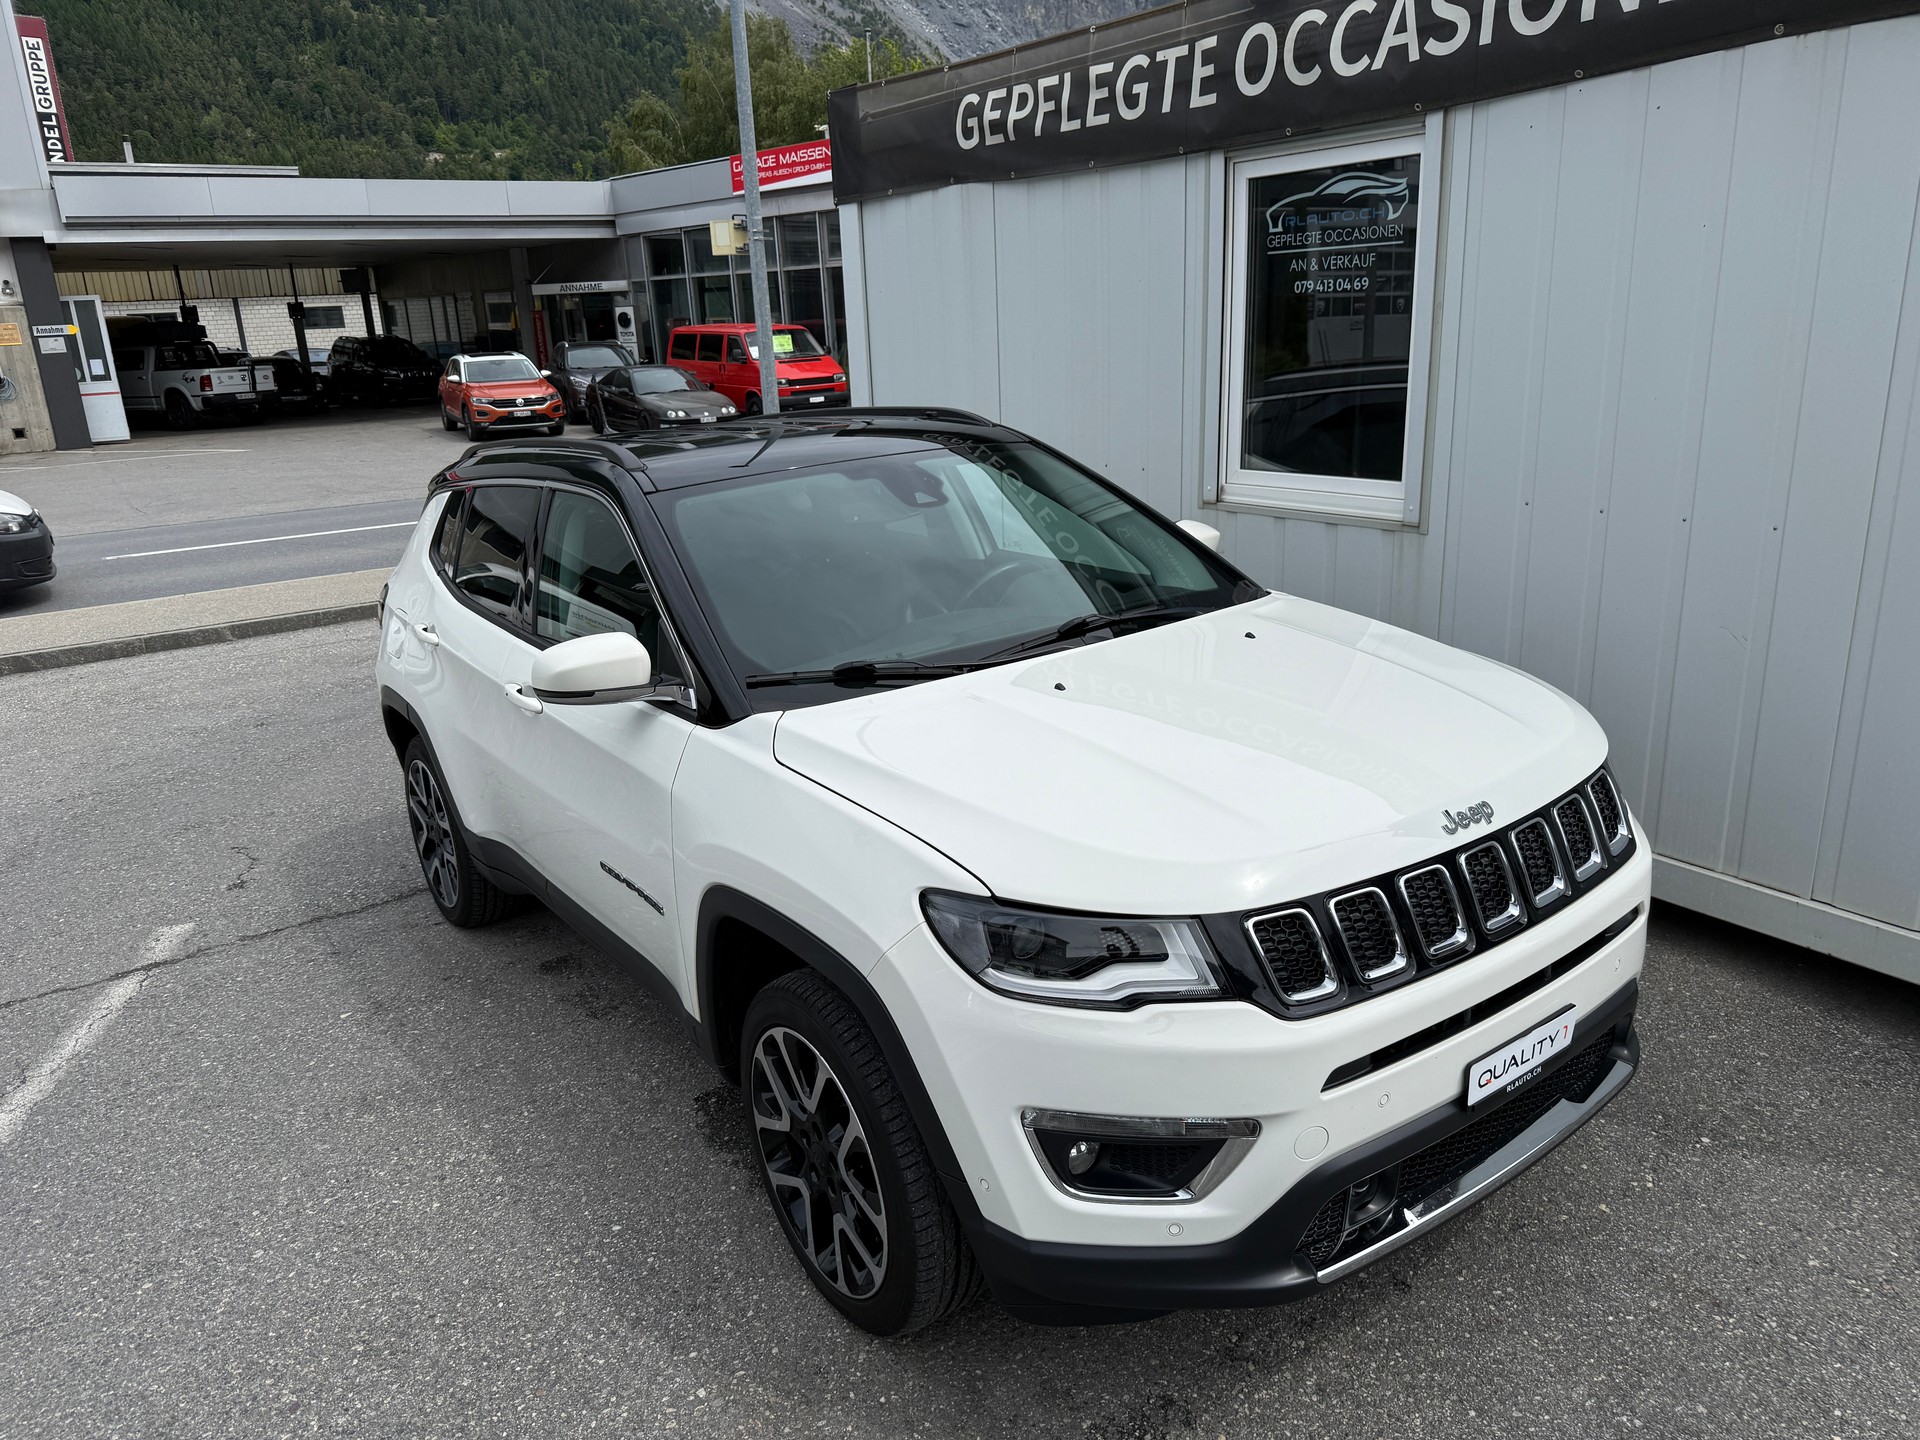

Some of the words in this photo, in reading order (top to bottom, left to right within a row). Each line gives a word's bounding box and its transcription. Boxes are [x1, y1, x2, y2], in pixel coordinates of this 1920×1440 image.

[25, 40, 53, 110] GRUPPE
[955, 35, 1218, 150] GEPFLEGTE
[1234, 0, 1677, 97] OCCASI
[732, 155, 777, 172] GAGE
[779, 145, 832, 165] MAISSEN
[793, 164, 810, 173] GROUP
[1285, 206, 1385, 227] RLAUTO.CH
[1266, 230, 1322, 248] GEPFLEGTE
[1324, 224, 1404, 243] OCCASIONEN
[1289, 258, 1307, 272] AN
[1310, 258, 1319, 271] &
[1322, 253, 1376, 270] VERKAUF
[560, 283, 604, 292] ANNAHME
[1294, 280, 1314, 294] 079
[1316, 279, 1334, 292] 413
[1336, 278, 1352, 291] 04
[1353, 277, 1369, 290] 69
[36, 326, 64, 335] Annahme
[1440, 800, 1495, 835] Jeep
[1477, 1028, 1560, 1089] QUALITY
[1563, 1024, 1569, 1040] 1
[1506, 1065, 1542, 1093] RLAUTO.CH
